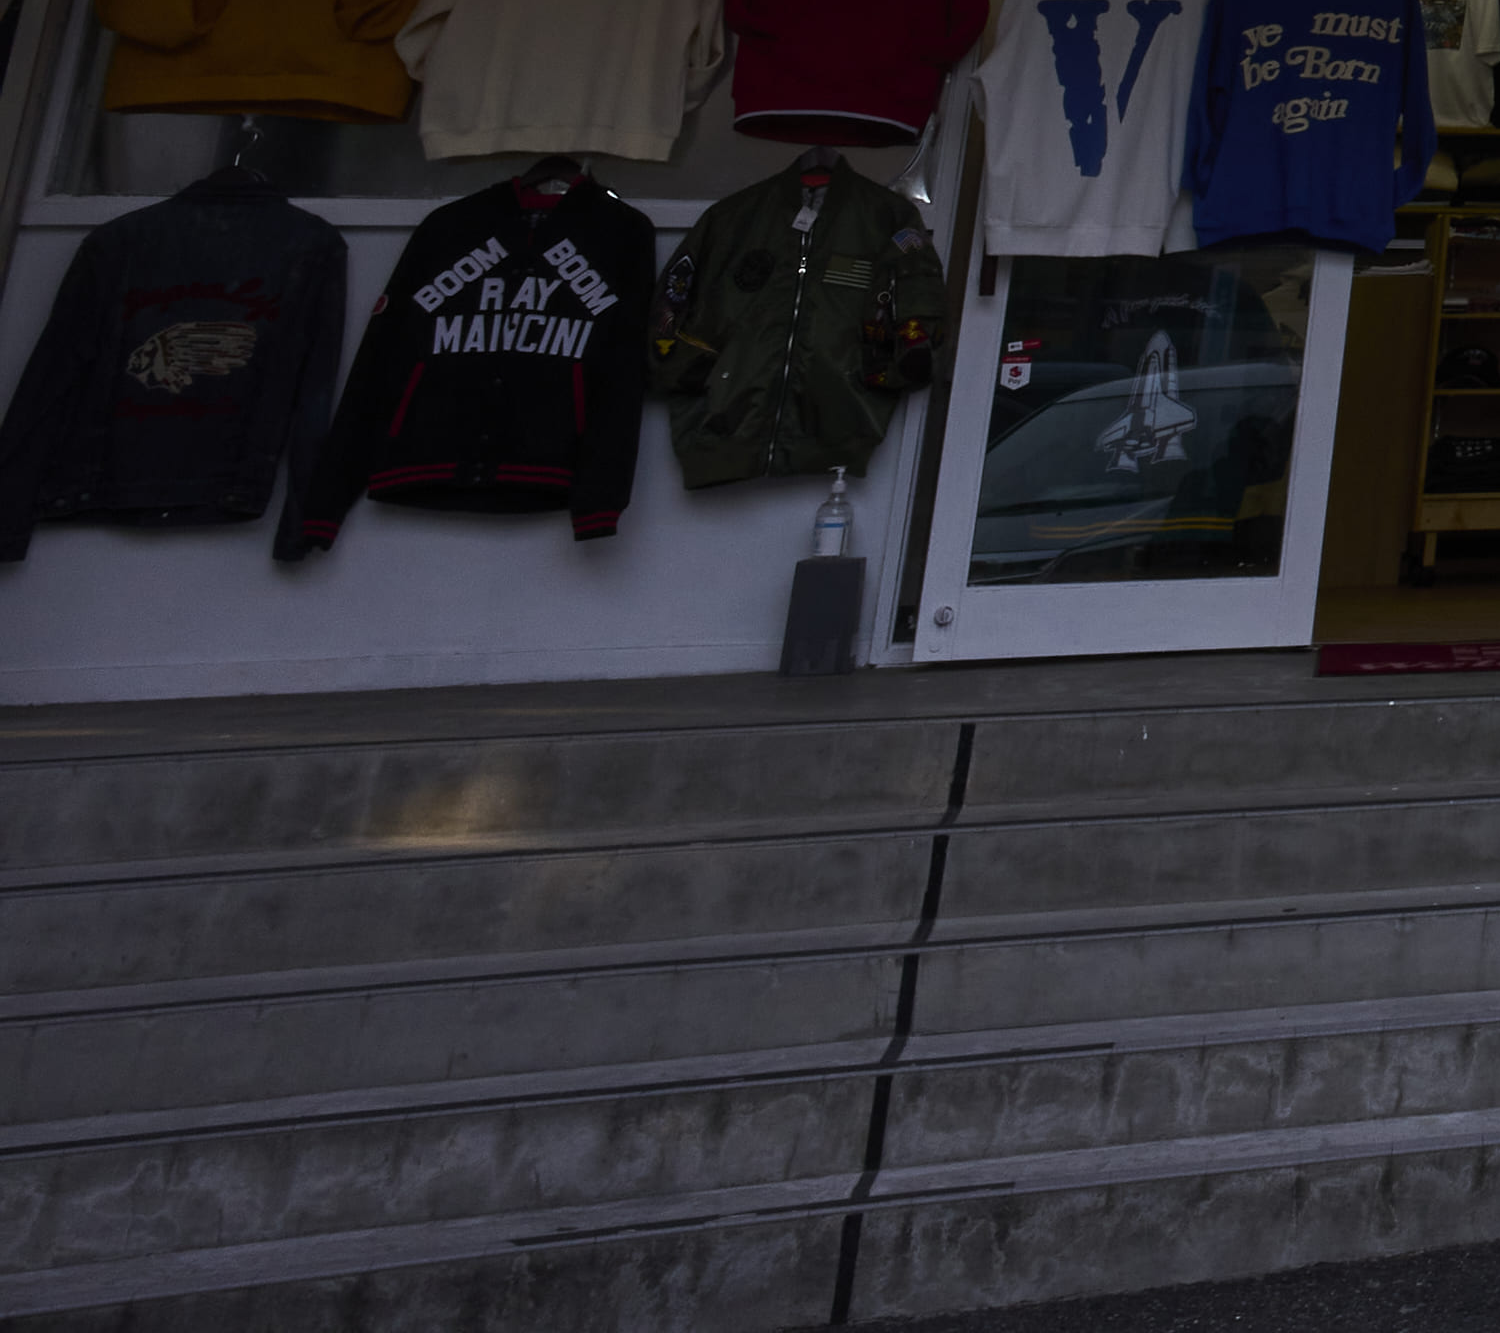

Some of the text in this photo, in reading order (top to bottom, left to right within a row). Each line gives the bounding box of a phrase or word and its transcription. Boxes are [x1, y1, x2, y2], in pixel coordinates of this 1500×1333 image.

[1241, 12, 1404, 55] ye must
[1240, 45, 1382, 91] be Born
[1272, 91, 1350, 134] again
[412, 236, 620, 317] BOOM BOOM
[479, 276, 564, 311] RAY
[432, 312, 595, 359] MANCINI
